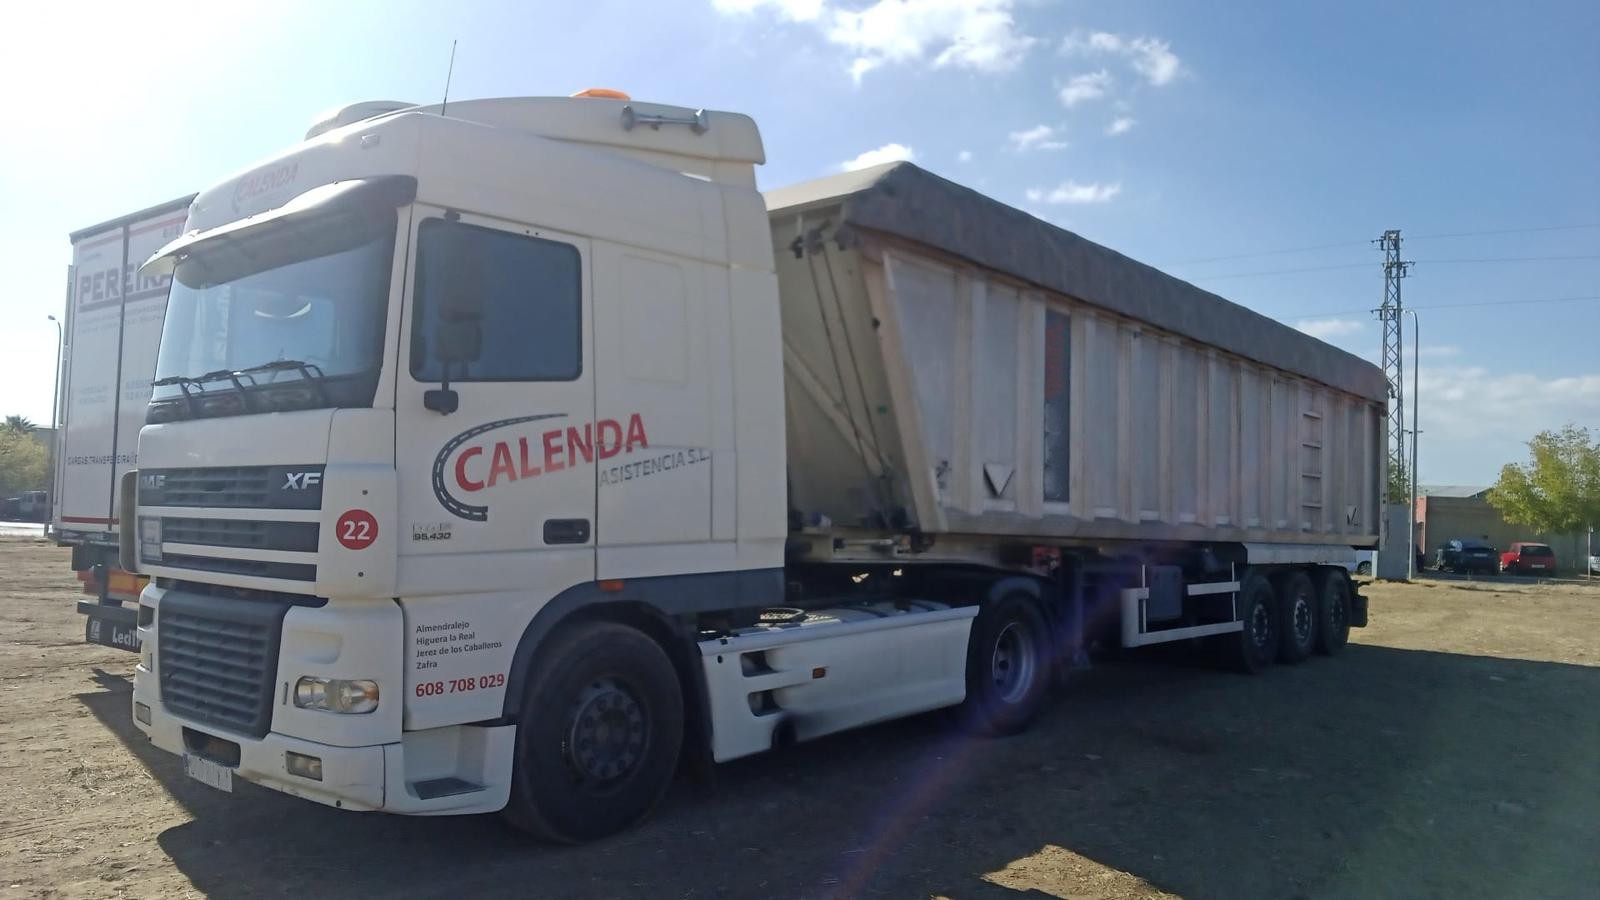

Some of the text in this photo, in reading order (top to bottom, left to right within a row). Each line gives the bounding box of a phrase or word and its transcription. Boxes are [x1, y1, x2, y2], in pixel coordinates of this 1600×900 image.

[454, 413, 648, 492] CALENDA
[599, 451, 685, 488] ASISTENCIA
[281, 472, 321, 490] XF
[344, 520, 370, 540] 22
[416, 621, 470, 633] Almendralejo
[416, 632, 475, 646] Higuera la Real
[416, 641, 502, 658] Jerez de los Caballeros
[416, 660, 438, 669] Zafra
[416, 673, 505, 697] 608 708 029
